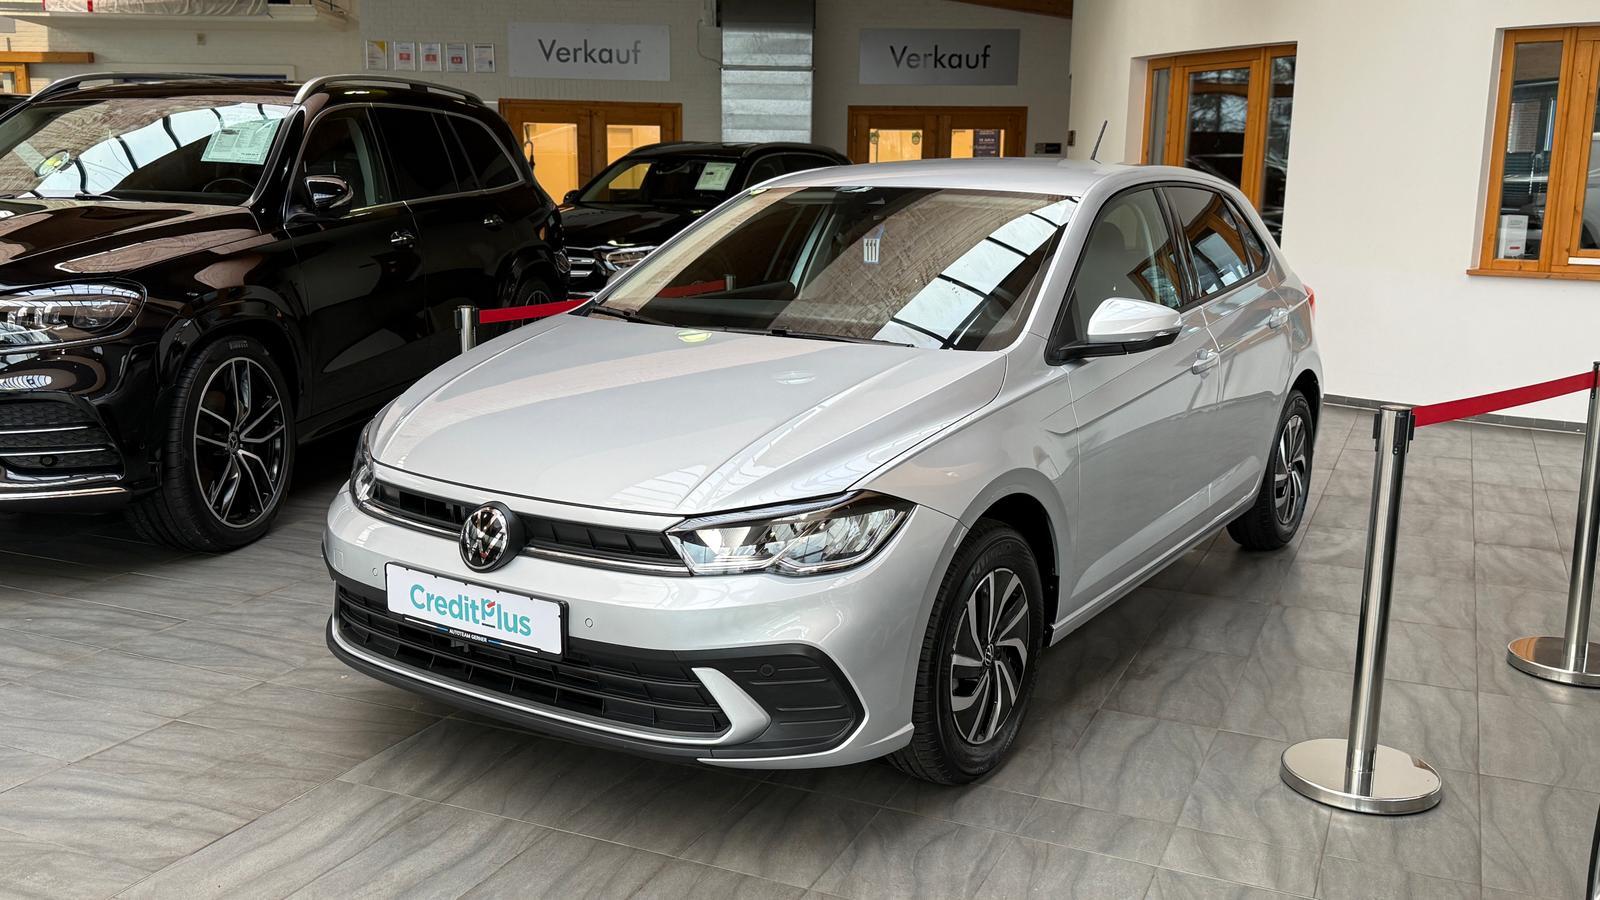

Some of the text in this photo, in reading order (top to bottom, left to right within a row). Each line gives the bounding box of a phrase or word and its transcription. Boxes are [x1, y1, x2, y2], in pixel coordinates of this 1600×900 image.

[537, 38, 642, 65] Verkauf
[889, 44, 992, 69] Verkauf
[410, 584, 532, 636] CreditPlus
